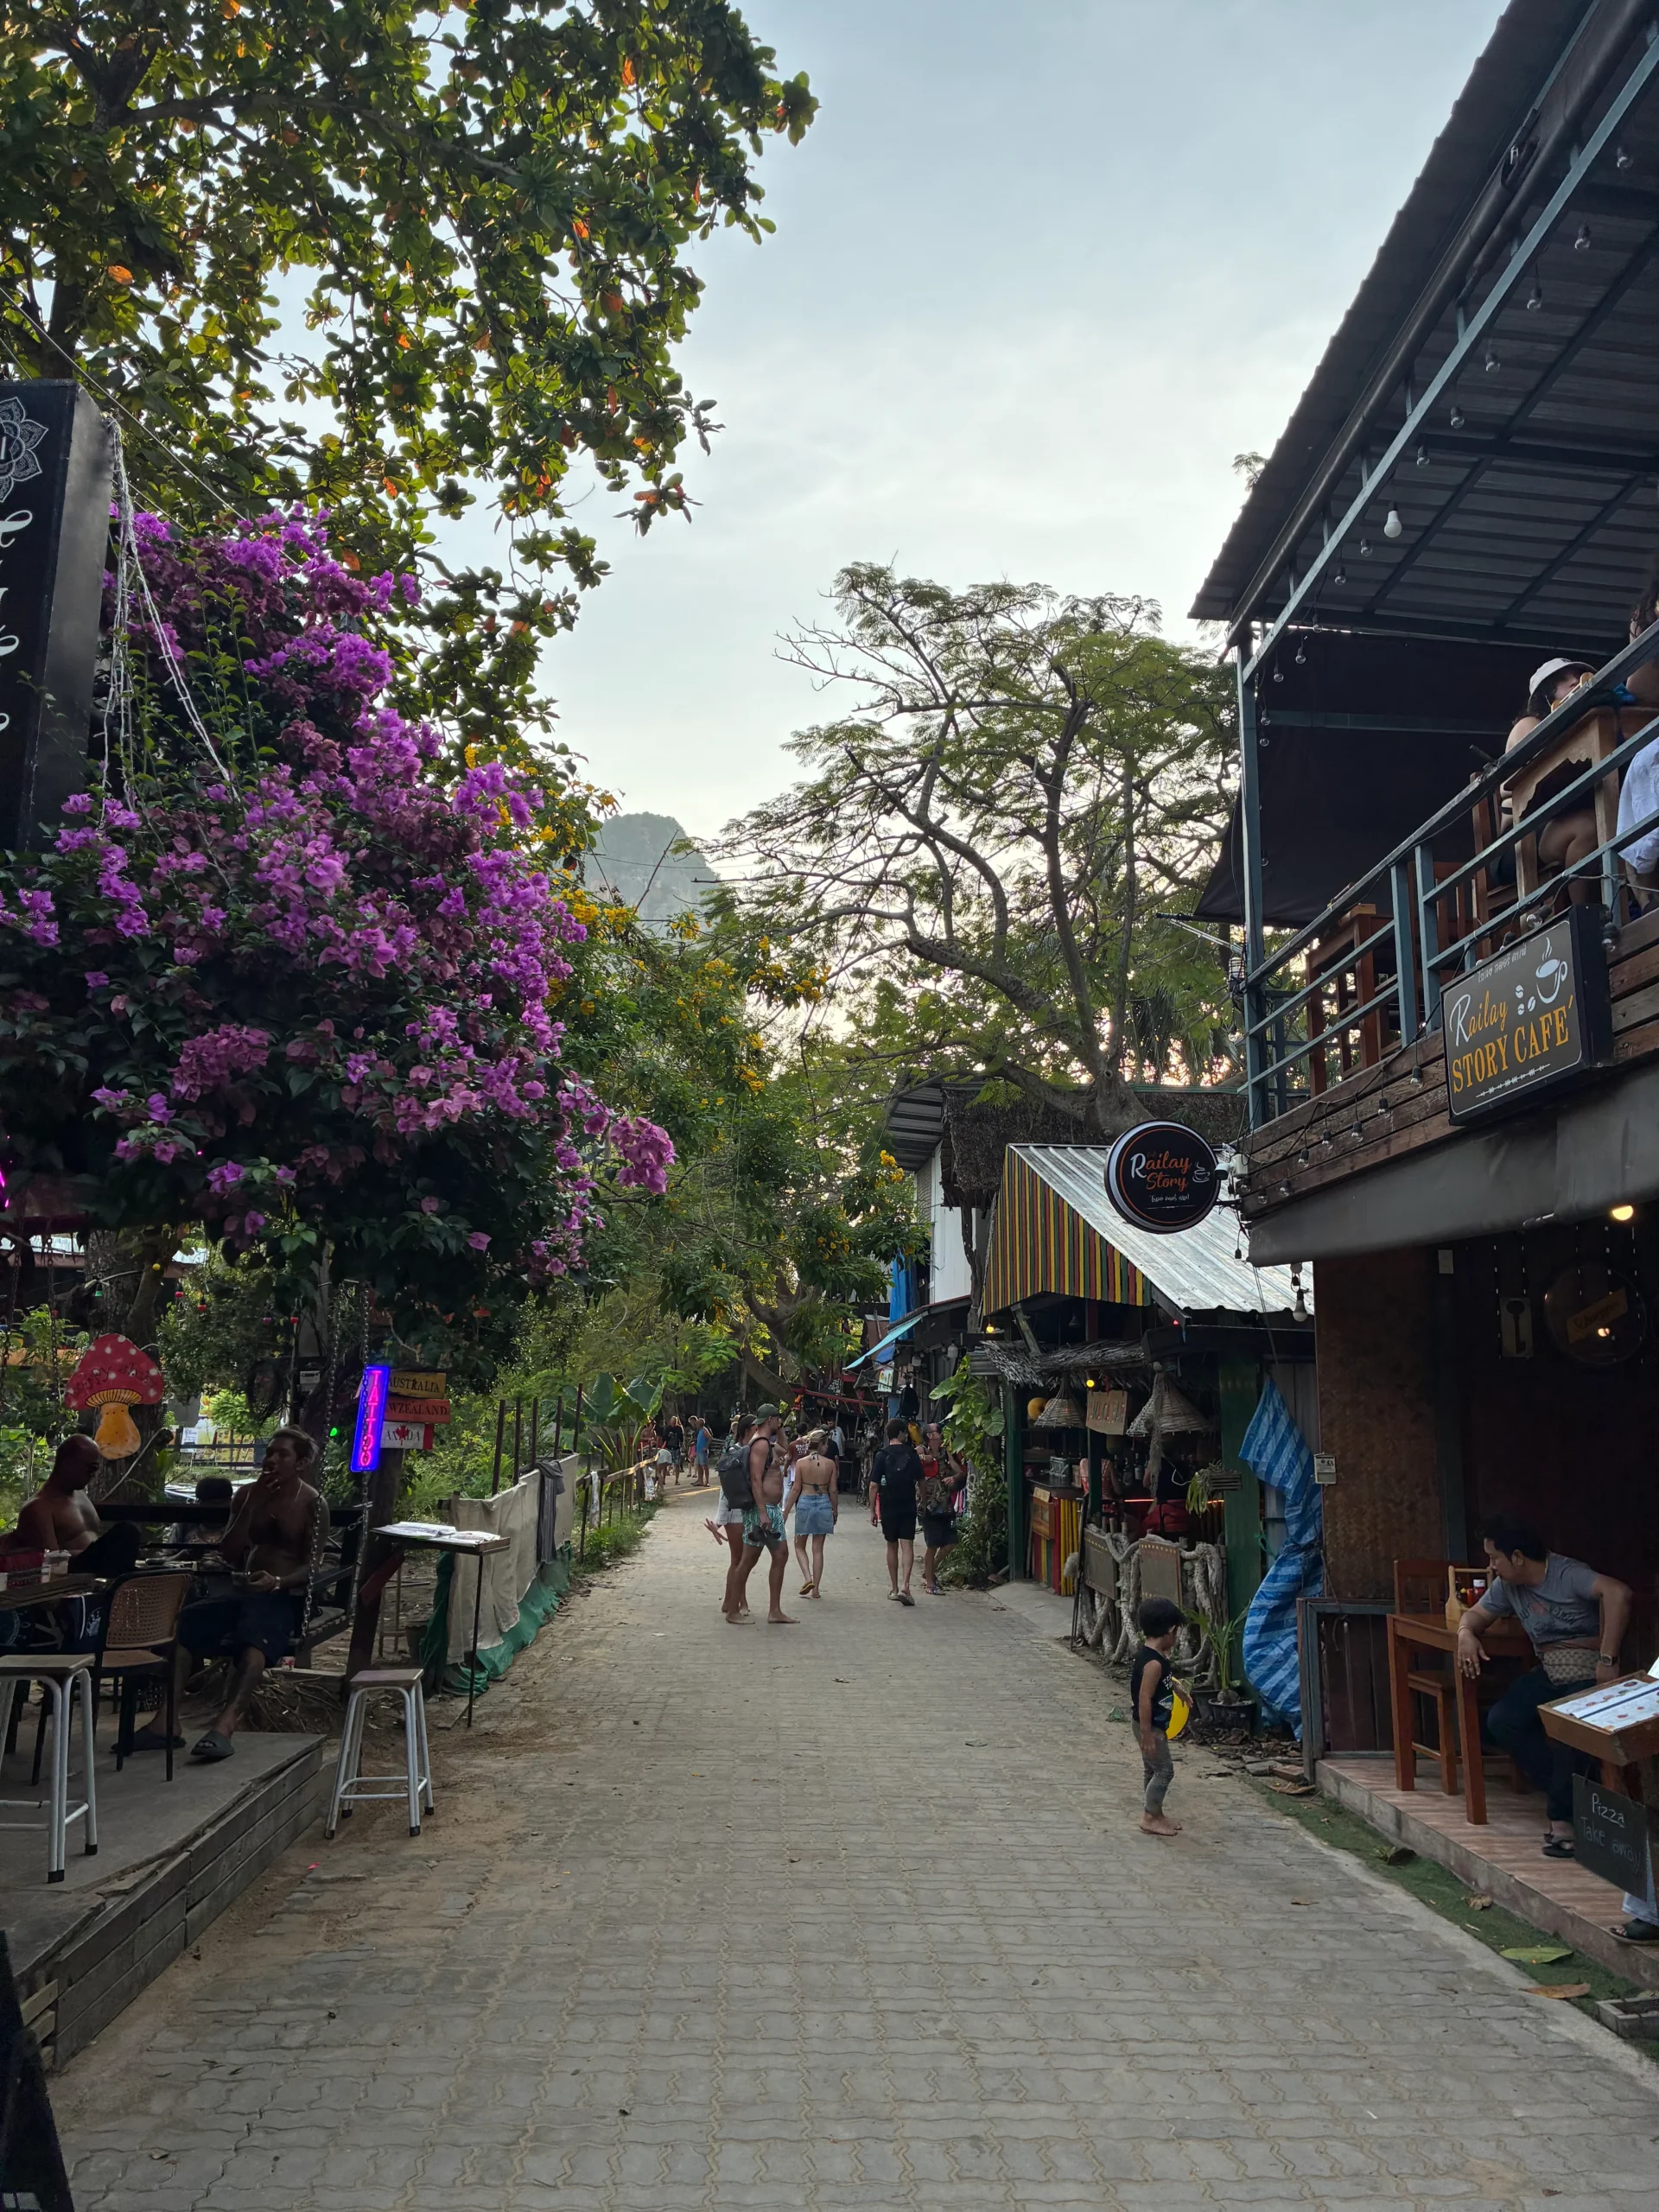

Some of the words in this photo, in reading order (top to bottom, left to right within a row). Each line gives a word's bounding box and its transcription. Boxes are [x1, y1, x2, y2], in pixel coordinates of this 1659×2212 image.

[1449, 990, 1509, 1046] Railay
[1452, 1035, 1509, 1093] STORY
[1130, 1151, 1192, 1179] Railay
[1146, 1172, 1189, 1192] Story
[359, 1370, 382, 1466] TATTOO
[385, 1402, 448, 1415] WZEALAND
[1592, 1792, 1624, 1828] Pizza
[1580, 1816, 1605, 1847] Take
